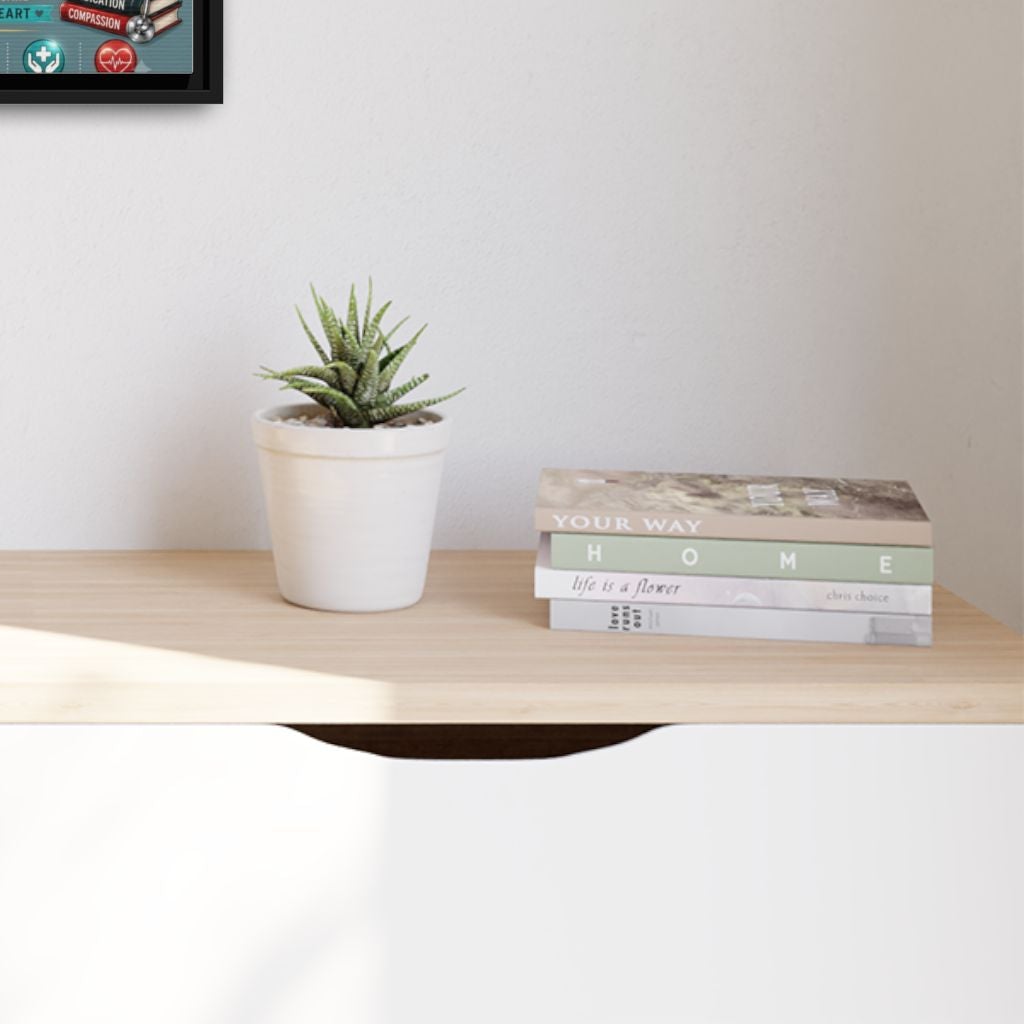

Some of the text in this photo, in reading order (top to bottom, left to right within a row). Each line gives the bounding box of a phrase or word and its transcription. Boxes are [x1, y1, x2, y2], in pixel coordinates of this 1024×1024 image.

[68, 8, 121, 30] COMPASSION
[552, 515, 702, 533] YOUR WAY
[571, 575, 682, 599] life is a flower
[826, 589, 852, 601] chris
[608, 605, 619, 630] love
[622, 605, 631, 631] runs
[632, 609, 641, 628] out
